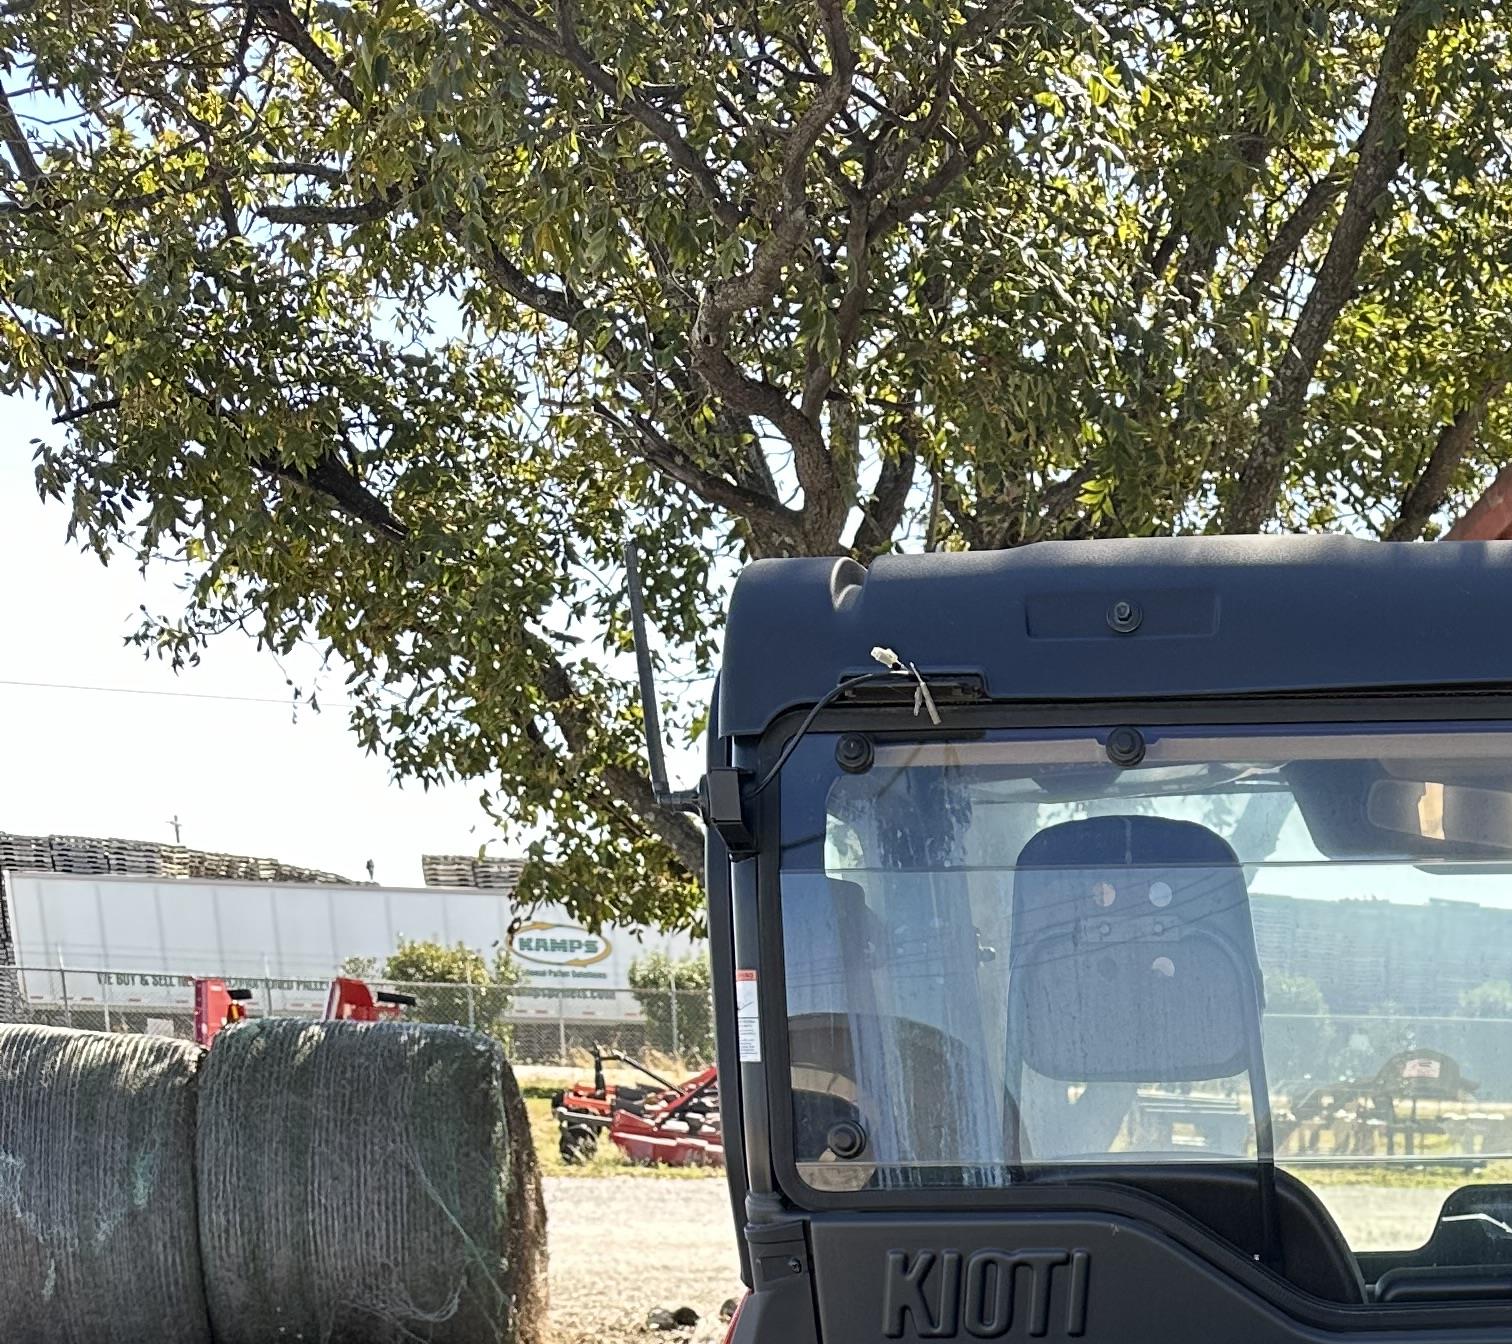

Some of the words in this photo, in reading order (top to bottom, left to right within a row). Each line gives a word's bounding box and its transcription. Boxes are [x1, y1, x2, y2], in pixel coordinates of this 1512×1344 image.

[519, 937, 598, 953] KAMPS
[117, 973, 136, 986] BUY
[152, 975, 175, 987] SELL
[883, 1248, 1092, 1339] KIOTI
